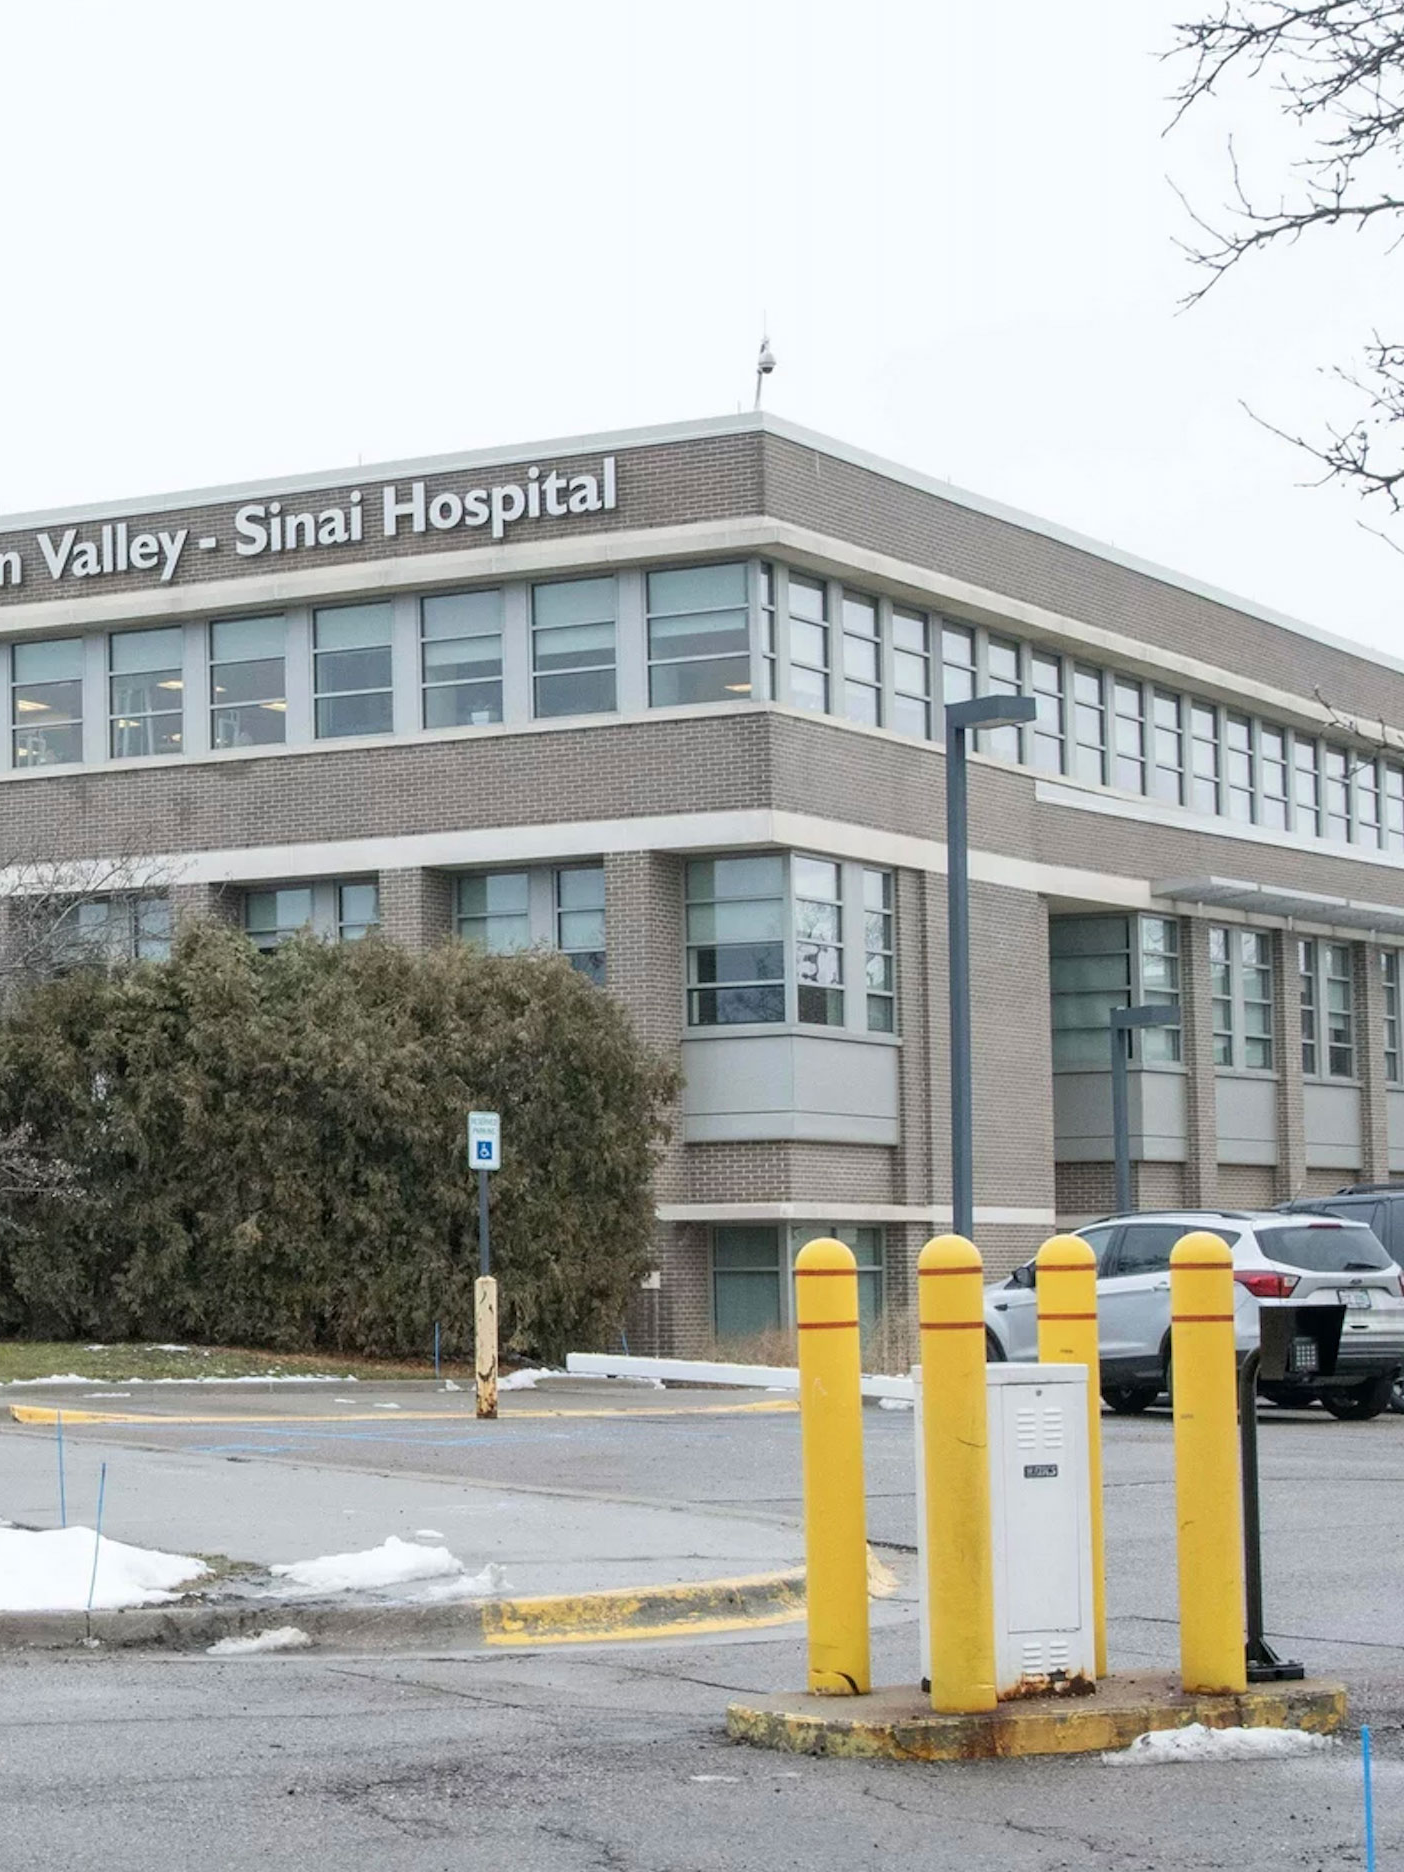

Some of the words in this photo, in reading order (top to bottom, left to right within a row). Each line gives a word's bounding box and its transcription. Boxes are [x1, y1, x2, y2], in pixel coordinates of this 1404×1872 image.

[37, 522, 189, 582] Valley
[199, 537, 217, 549] -
[234, 490, 363, 556] Sinai
[383, 456, 617, 538] Hospital
